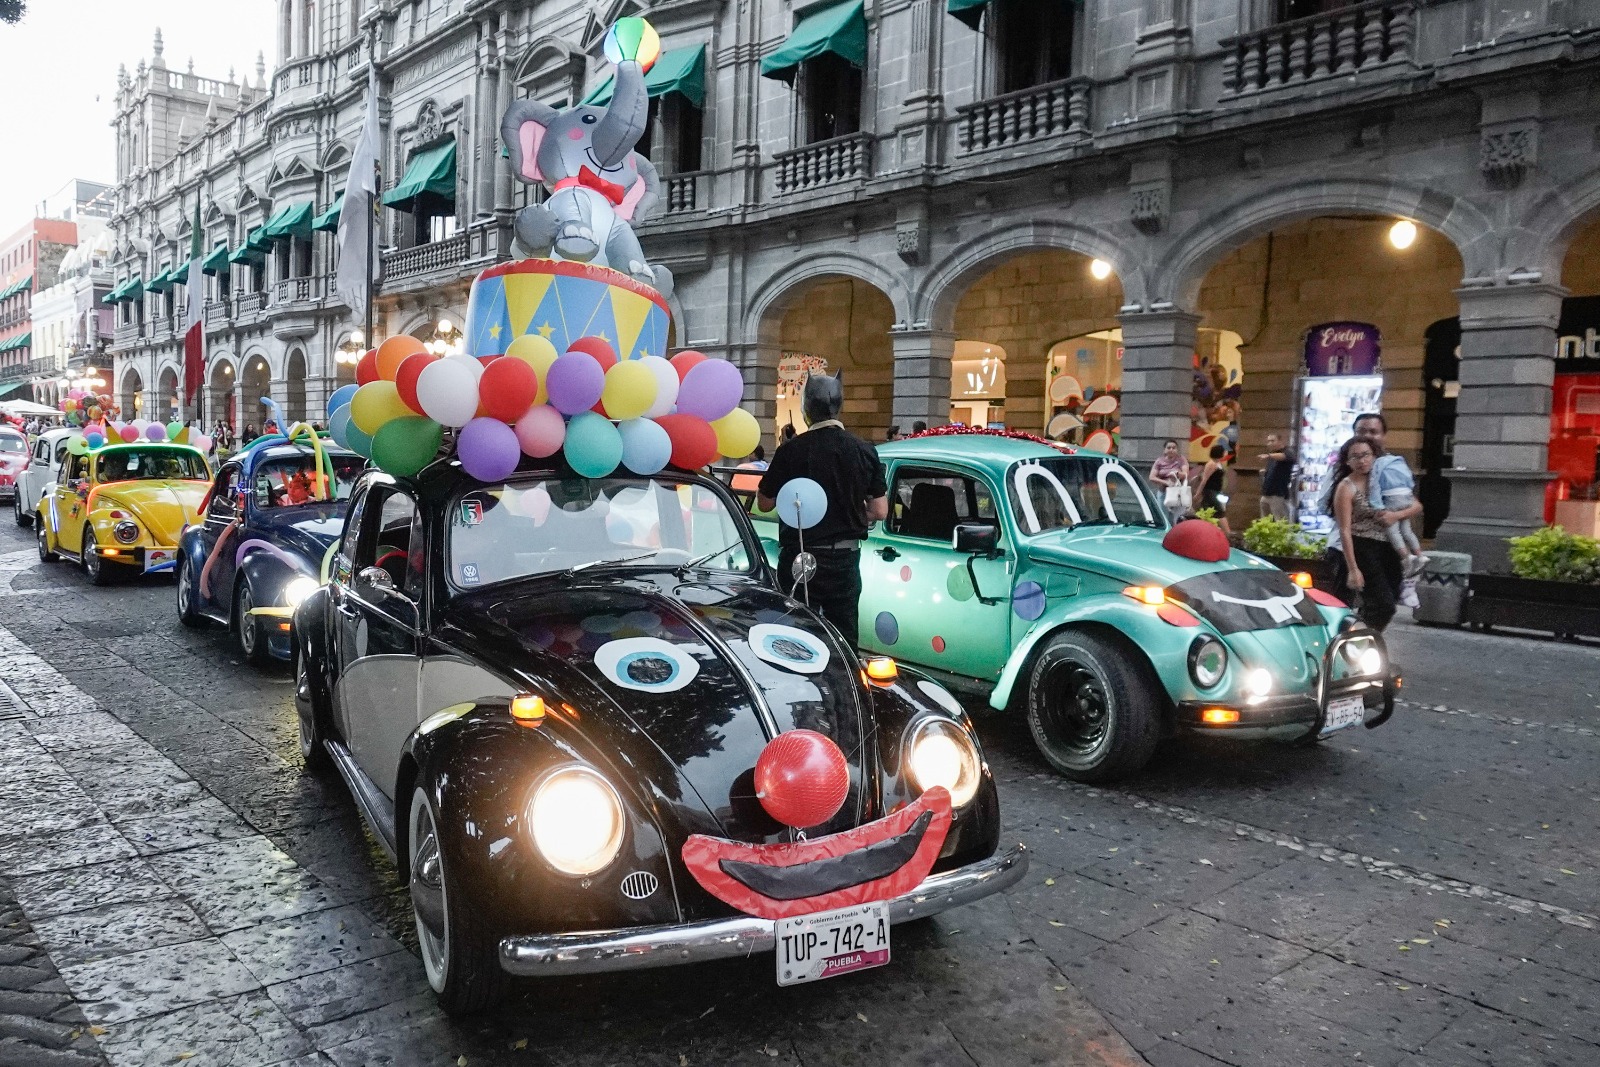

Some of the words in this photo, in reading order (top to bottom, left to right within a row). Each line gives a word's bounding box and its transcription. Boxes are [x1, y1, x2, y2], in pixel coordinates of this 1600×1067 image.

[431, 35, 477, 72] MUNICIPAL
[1320, 327, 1366, 349] Evelyn
[1032, 654, 1051, 689] COBRA
[809, 916, 834, 925] Gobierno
[841, 911, 859, 919] Puebla
[781, 918, 887, 964] TUP-742-A
[828, 954, 862, 969] PUEBLA
